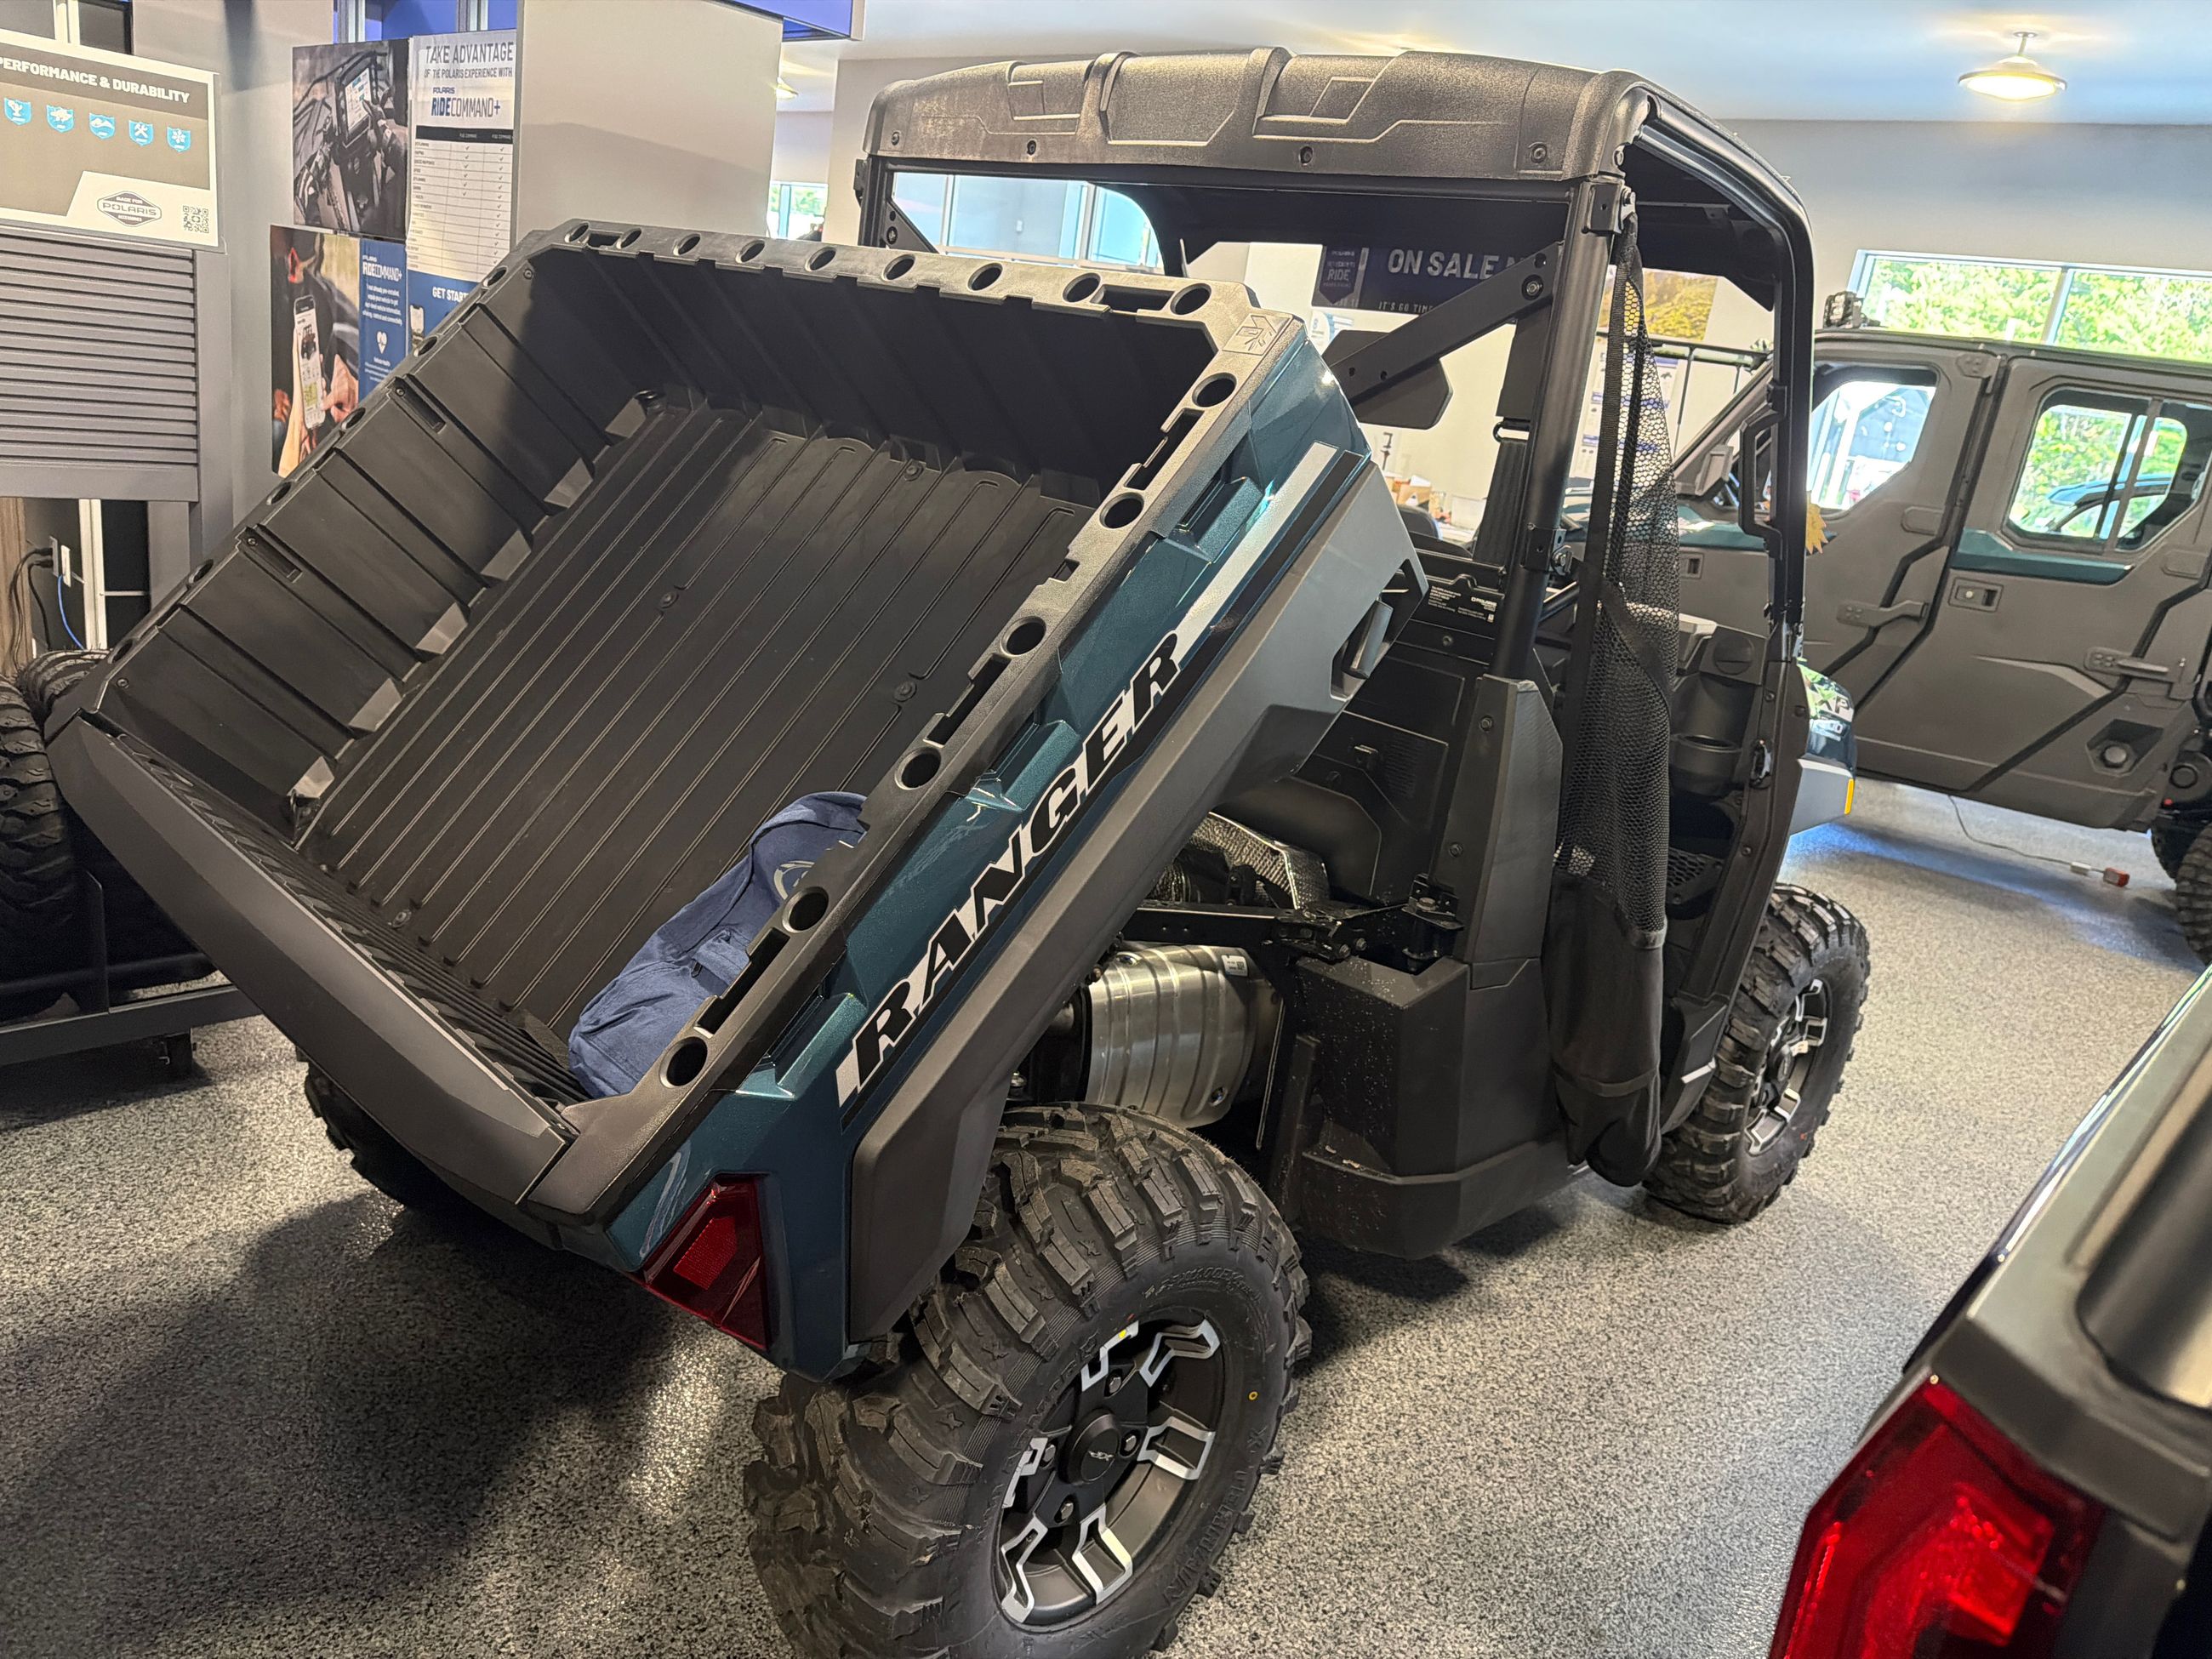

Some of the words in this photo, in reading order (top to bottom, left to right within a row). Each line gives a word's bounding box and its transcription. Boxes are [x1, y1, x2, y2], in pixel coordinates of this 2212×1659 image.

[426, 45, 450, 64] TAKE
[453, 41, 514, 64] ADVANTAGE
[442, 68, 465, 79] POLARIS
[465, 67, 498, 78] EXPERIENCE
[498, 66, 513, 77] WITH
[99, 76, 111, 89] &
[112, 77, 190, 104] DURABILITY
[430, 96, 501, 117] RIDECOMMAND+
[102, 202, 157, 216] POLARIS
[1388, 248, 1423, 275] ON
[1427, 250, 1500, 280] SALE
[432, 286, 446, 299] GET
[1378, 300, 1396, 311] IT'S
[1398, 302, 1410, 312] GO
[836, 630, 1181, 1108] RANGER
